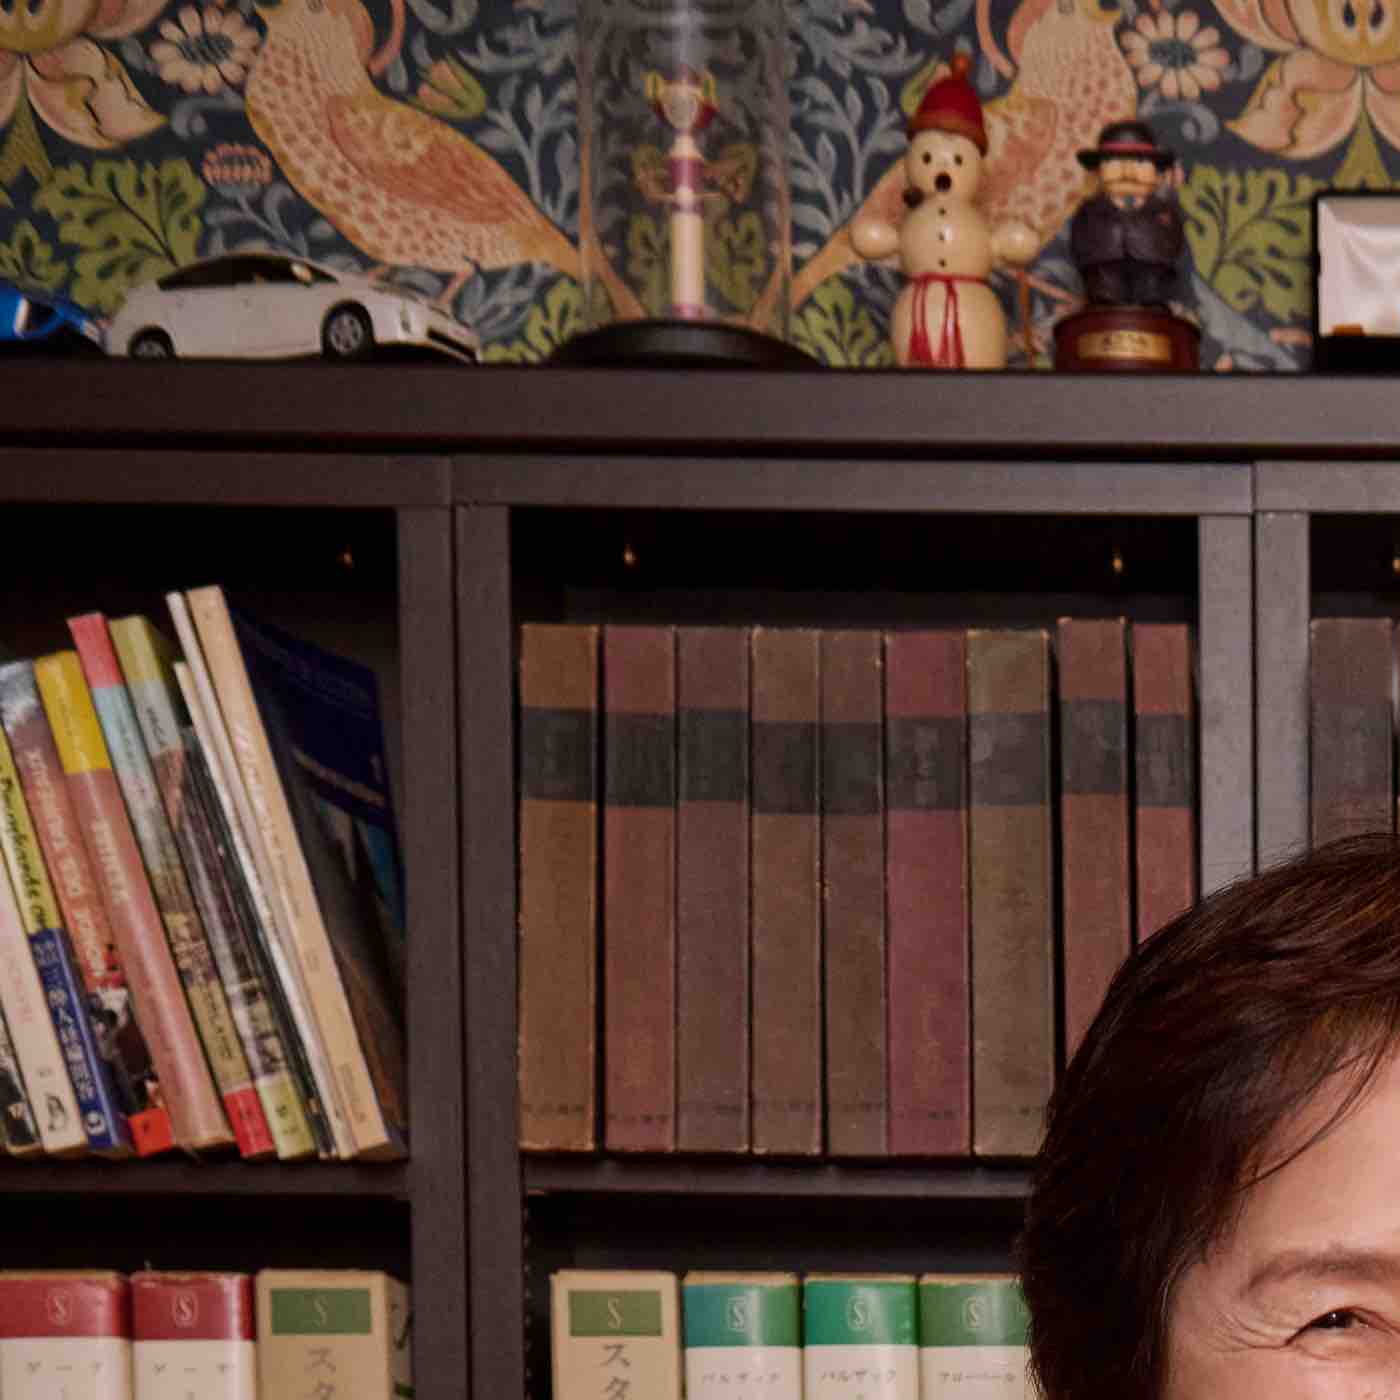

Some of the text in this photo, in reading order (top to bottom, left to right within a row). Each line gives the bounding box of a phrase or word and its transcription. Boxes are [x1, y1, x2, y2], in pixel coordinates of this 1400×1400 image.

[606, 1298, 622, 1330] S
[820, 1370, 899, 1384] バルザック
